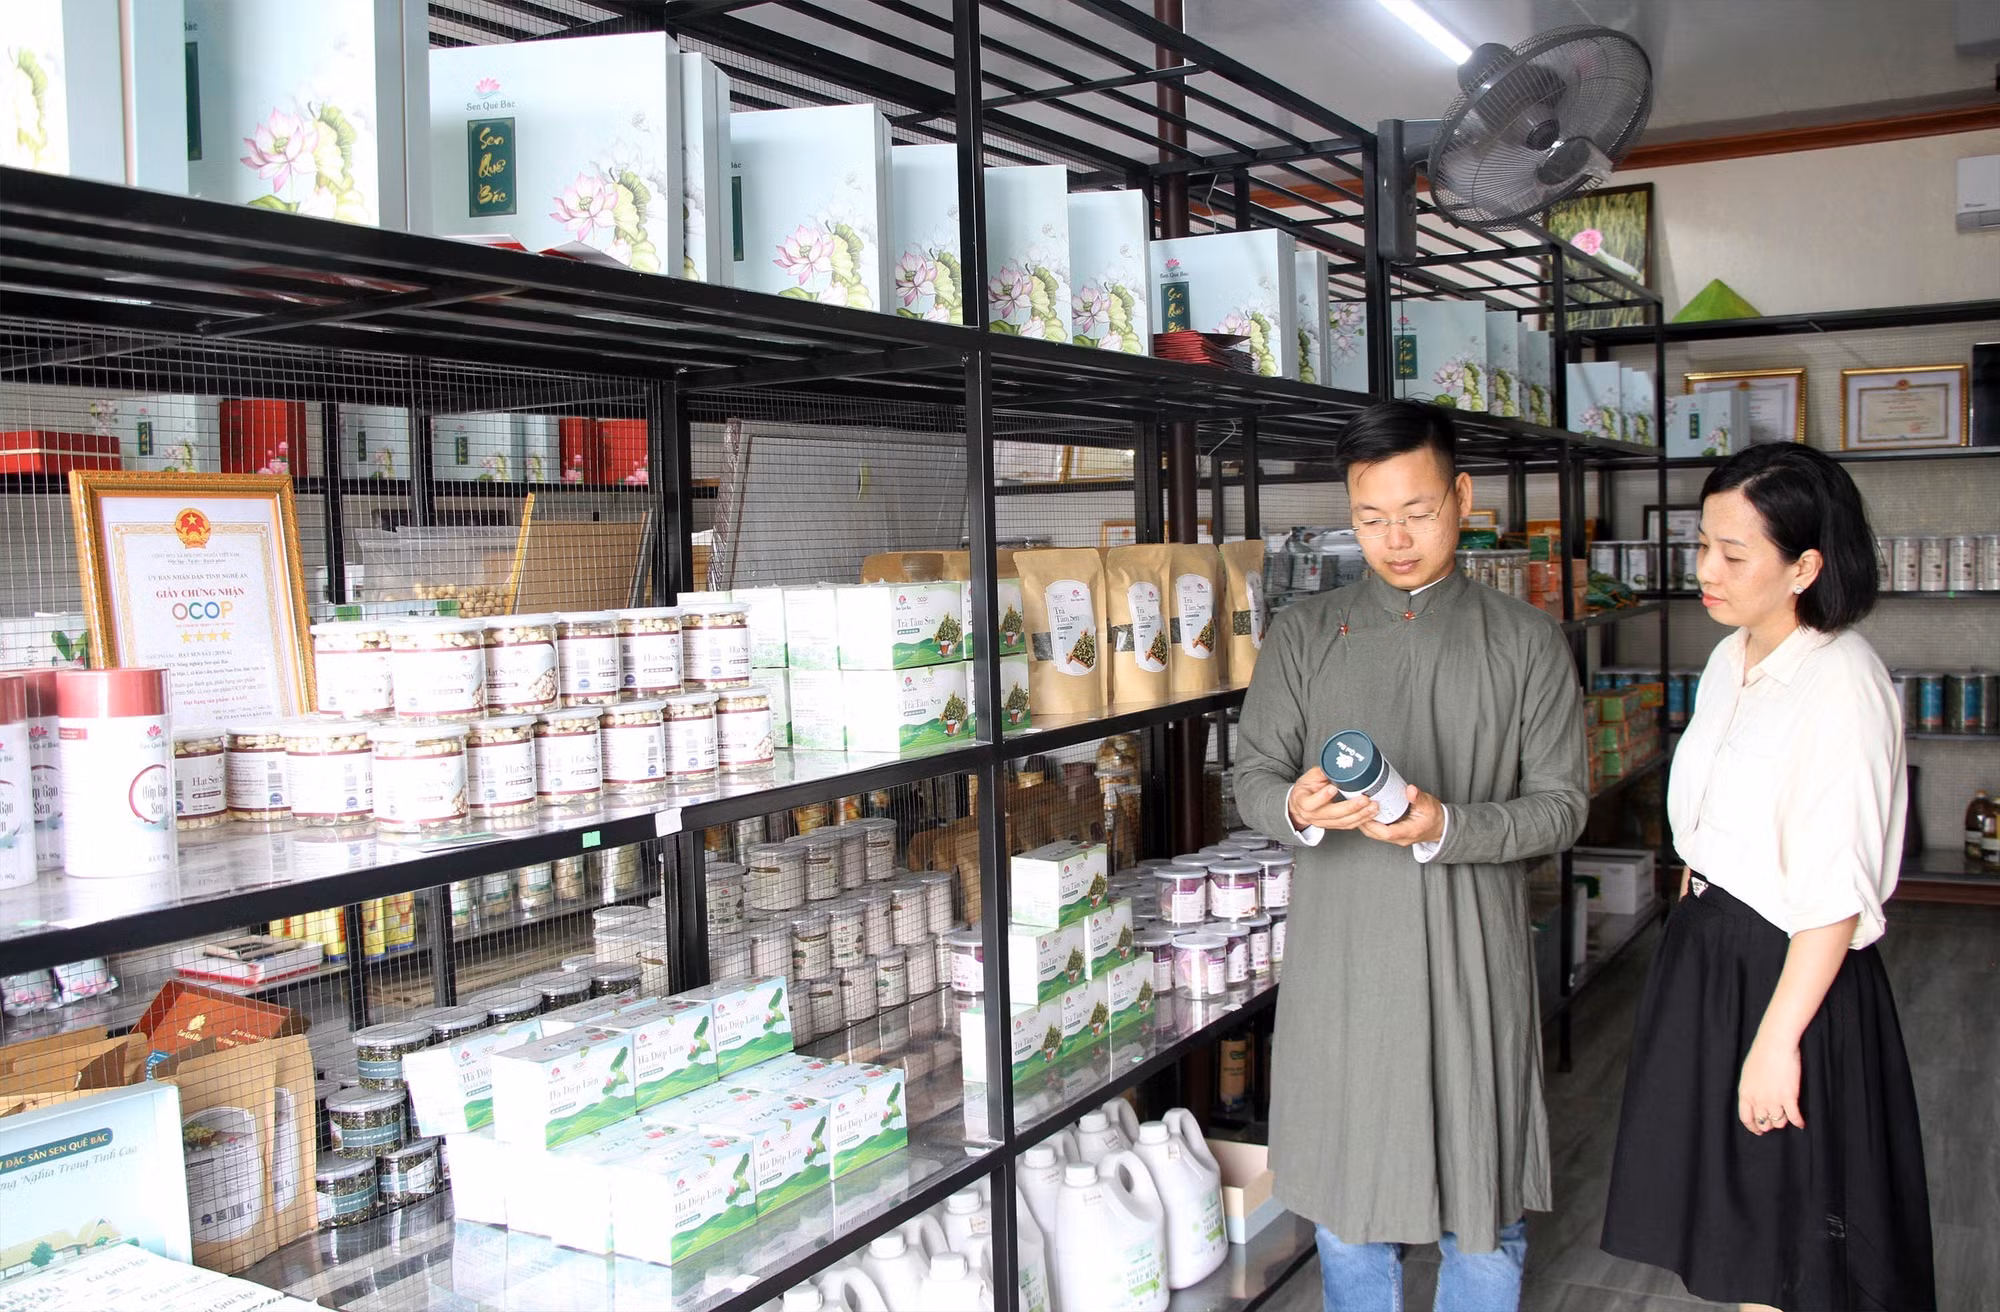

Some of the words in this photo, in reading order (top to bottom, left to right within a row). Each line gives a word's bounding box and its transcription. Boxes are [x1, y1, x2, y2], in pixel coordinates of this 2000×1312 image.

[466, 103, 481, 111] Sen
[482, 101, 498, 111] Quê
[479, 127, 504, 150] Sen
[478, 152, 506, 178] Quê
[478, 183, 508, 205] Bác
[156, 586, 178, 598] GIẤY
[181, 586, 216, 598] CHỨNG
[218, 586, 245, 598] NHẬN
[172, 600, 234, 621] OCOP
[1053, 606, 1066, 615] Trà
[896, 618, 908, 628] Trà
[909, 617, 924, 626] Tâm
[924, 616, 936, 626] Sen
[1056, 615, 1069, 623] Tâm
[1069, 614, 1080, 622] Sen
[902, 700, 915, 710] Trà
[915, 698, 930, 708] Tâm
[930, 696, 942, 706] Sen
[192, 776, 208, 787] Hạt
[208, 774, 218, 784] Sen
[42, 786, 58, 800] Gạo
[34, 802, 50, 815] Sen
[151, 802, 164, 815] Sen
[1062, 885, 1070, 893] Trà
[717, 1023, 728, 1034] Hà
[745, 1014, 760, 1024] Liên
[638, 1054, 650, 1065] Hà
[669, 1043, 684, 1054] Liên
[462, 1072, 475, 1083] Hà
[550, 1090, 561, 1100] Hà
[583, 1077, 598, 1088] Liên
[836, 1123, 847, 1133] Hà
[864, 1111, 878, 1122] Liên
[6, 1155, 26, 1168] ĐẶC
[28, 1150, 47, 1162] SẢN
[49, 1144, 67, 1156] SEN
[68, 1138, 88, 1151] QUÊ
[90, 1133, 108, 1145] BÁC
[760, 1160, 770, 1172] Hà
[788, 1147, 802, 1159] Liên
[675, 1202, 686, 1213] Hà
[707, 1186, 723, 1199] Liên
